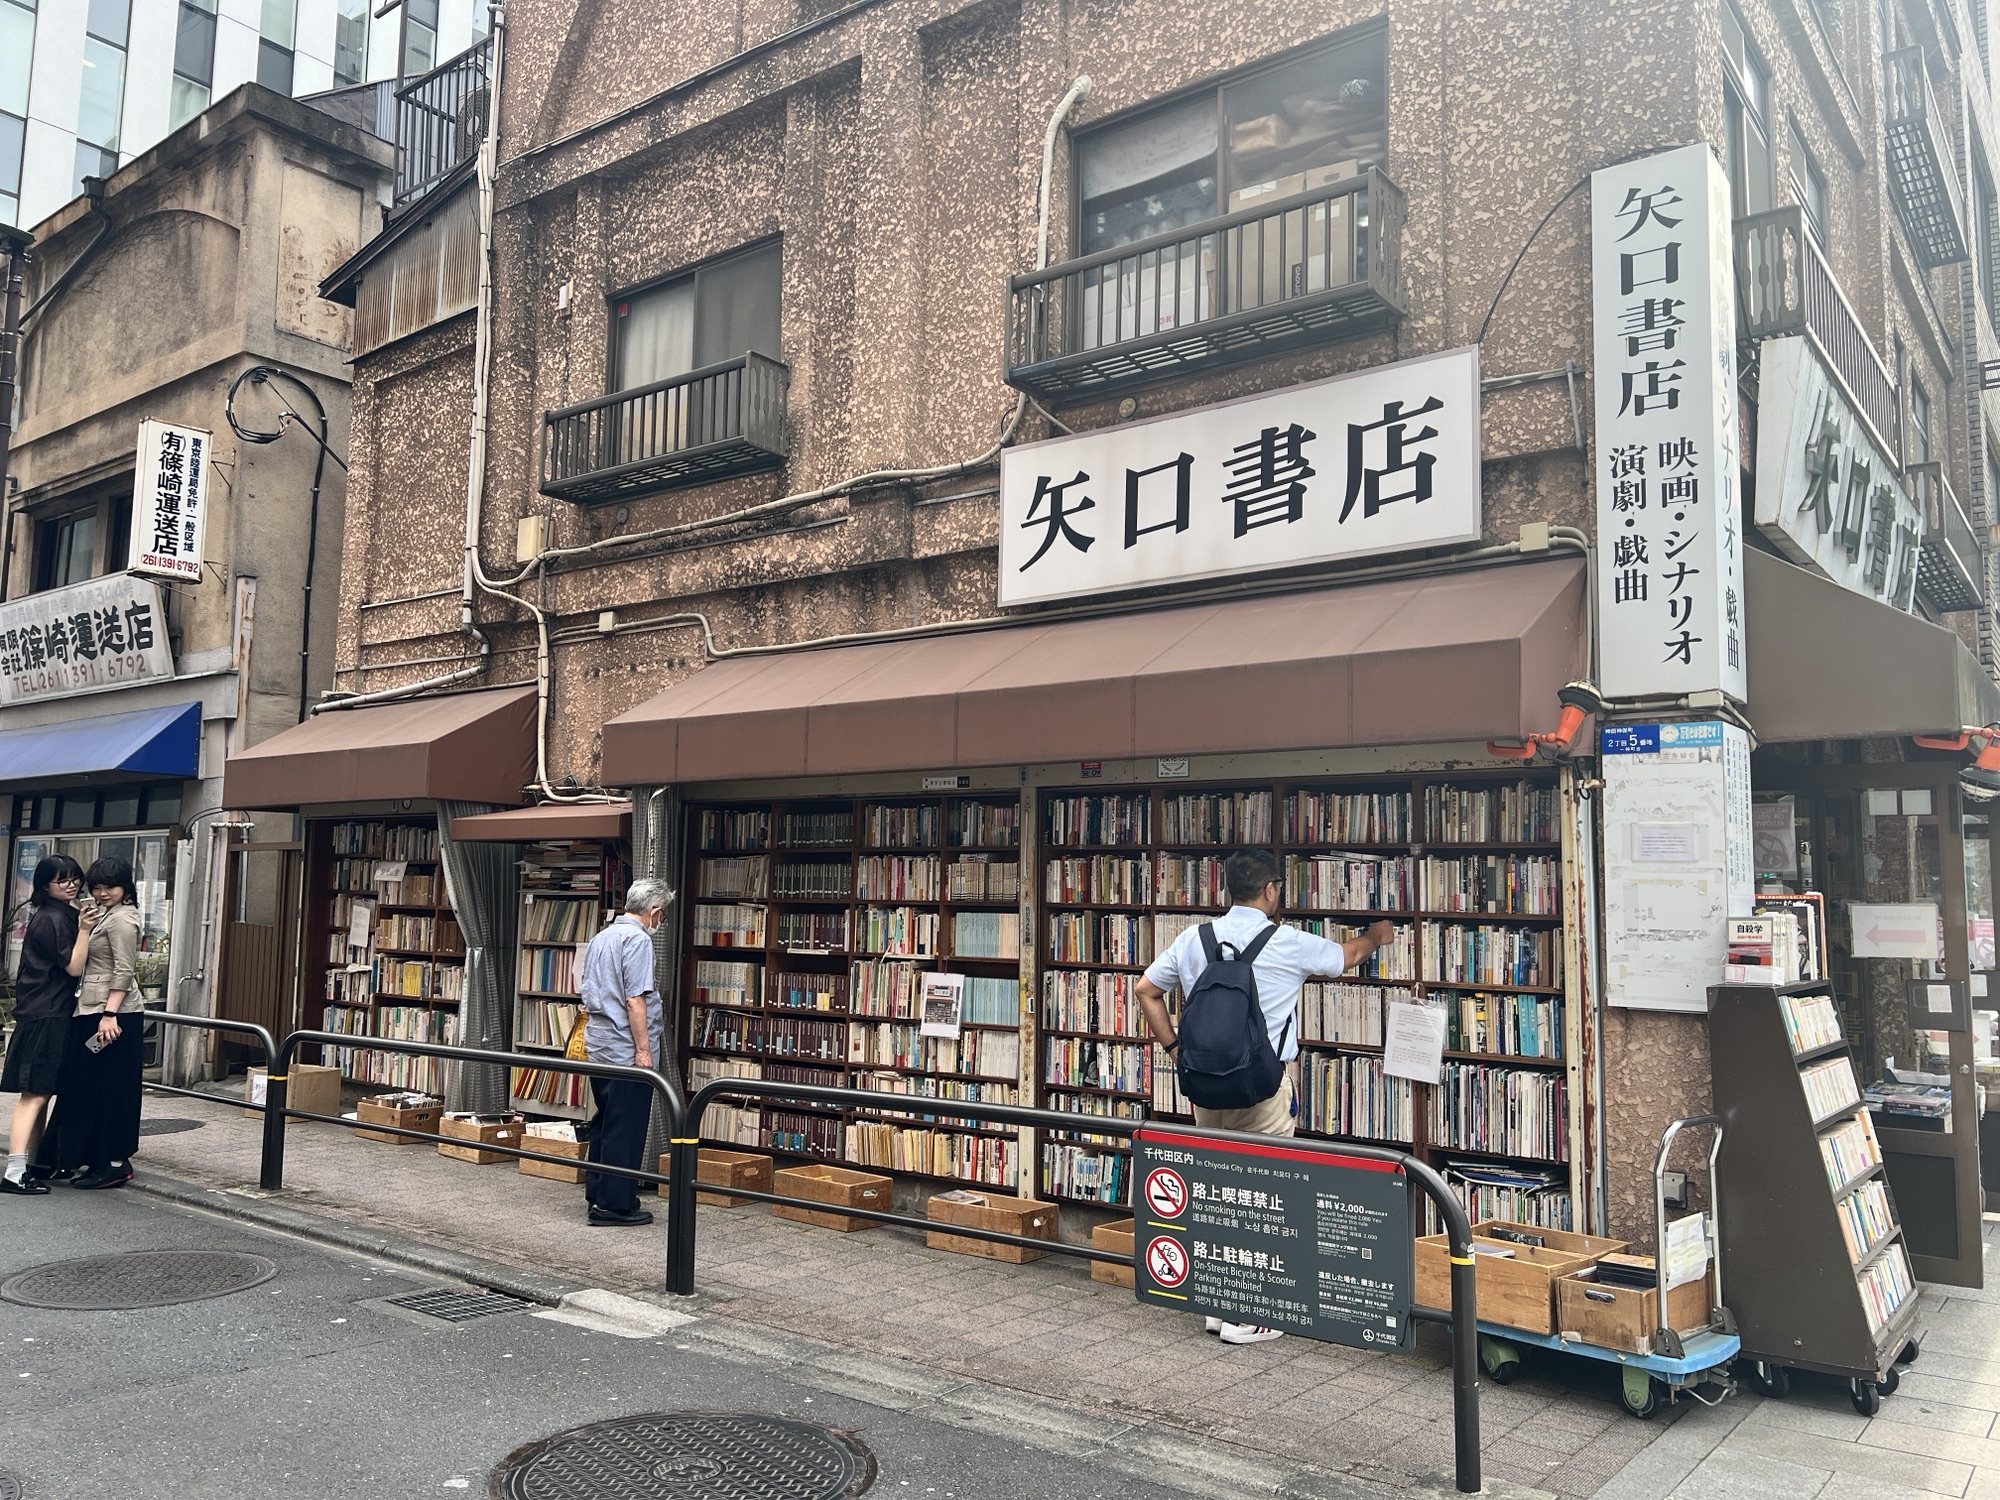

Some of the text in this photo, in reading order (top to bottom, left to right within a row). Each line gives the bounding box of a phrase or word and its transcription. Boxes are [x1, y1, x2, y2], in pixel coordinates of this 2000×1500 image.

[1613, 184, 1687, 419] 矢口書店
[1018, 396, 1444, 573] 矢口書店
[1609, 445, 1648, 604] 演劇・戯曲
[1658, 436, 1702, 665] 映画・シナリオ
[21, 600, 153, 670] 篠崎運送店
[1608, 734, 1653, 747] 2丁目5番地
[1737, 924, 1763, 934] 自殺学
[1143, 1147, 1194, 1165] 千代田区内
[1204, 1160, 1230, 1171] Chiyoda
[1231, 1163, 1244, 1173] City
[1192, 1182, 1285, 1212] 路上喫煙禁止
[1192, 1202, 1286, 1224] No smoking on the street
[1281, 1225, 1299, 1238] 금지
[1193, 1240, 1285, 1273] 路上駐輪禁止
[1194, 1259, 1297, 1288] On-Street Bicycle & Scooter
[1194, 1271, 1262, 1293] Parking Prohibited
[1376, 1332, 1396, 1341] 千代田区
